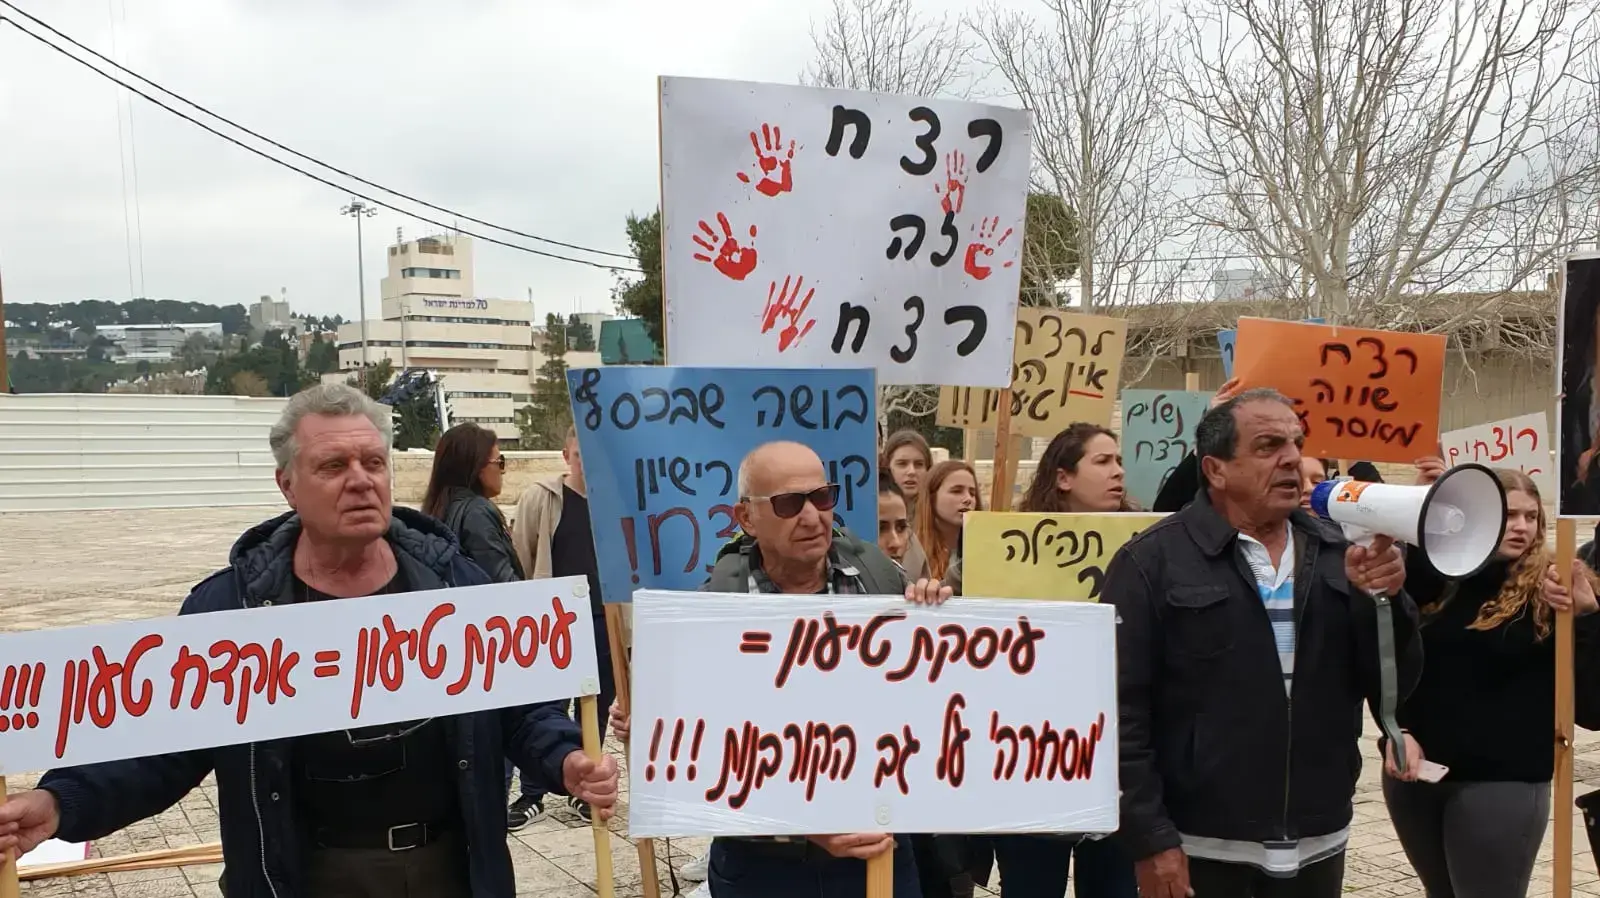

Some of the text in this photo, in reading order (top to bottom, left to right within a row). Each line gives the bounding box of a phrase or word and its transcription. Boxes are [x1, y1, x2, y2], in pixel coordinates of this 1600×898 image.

[825, 105, 1002, 175] רצח
[886, 210, 959, 267] זה
[475, 298, 488, 310] 70
[831, 295, 987, 363] רצח
[1059, 361, 1108, 407] אין
[1319, 337, 1418, 379] רצח
[575, 367, 869, 431] בושה שבכסף
[1309, 378, 1399, 412] שווה
[1326, 417, 1423, 448] מאסר
[1449, 425, 1538, 468] רוצחים
[634, 456, 733, 511] רישיון
[1001, 518, 1103, 568] תהילה
[350, 602, 456, 720] טיעון
[446, 596, 577, 696] עיסקת
[773, 608, 909, 689] טיעון
[885, 615, 1045, 684] עיסקת
[55, 633, 164, 759] טעון
[170, 637, 300, 725] אקדח
[704, 719, 858, 811] הקורבנות
[874, 723, 921, 796] גב
[937, 692, 971, 789] על
